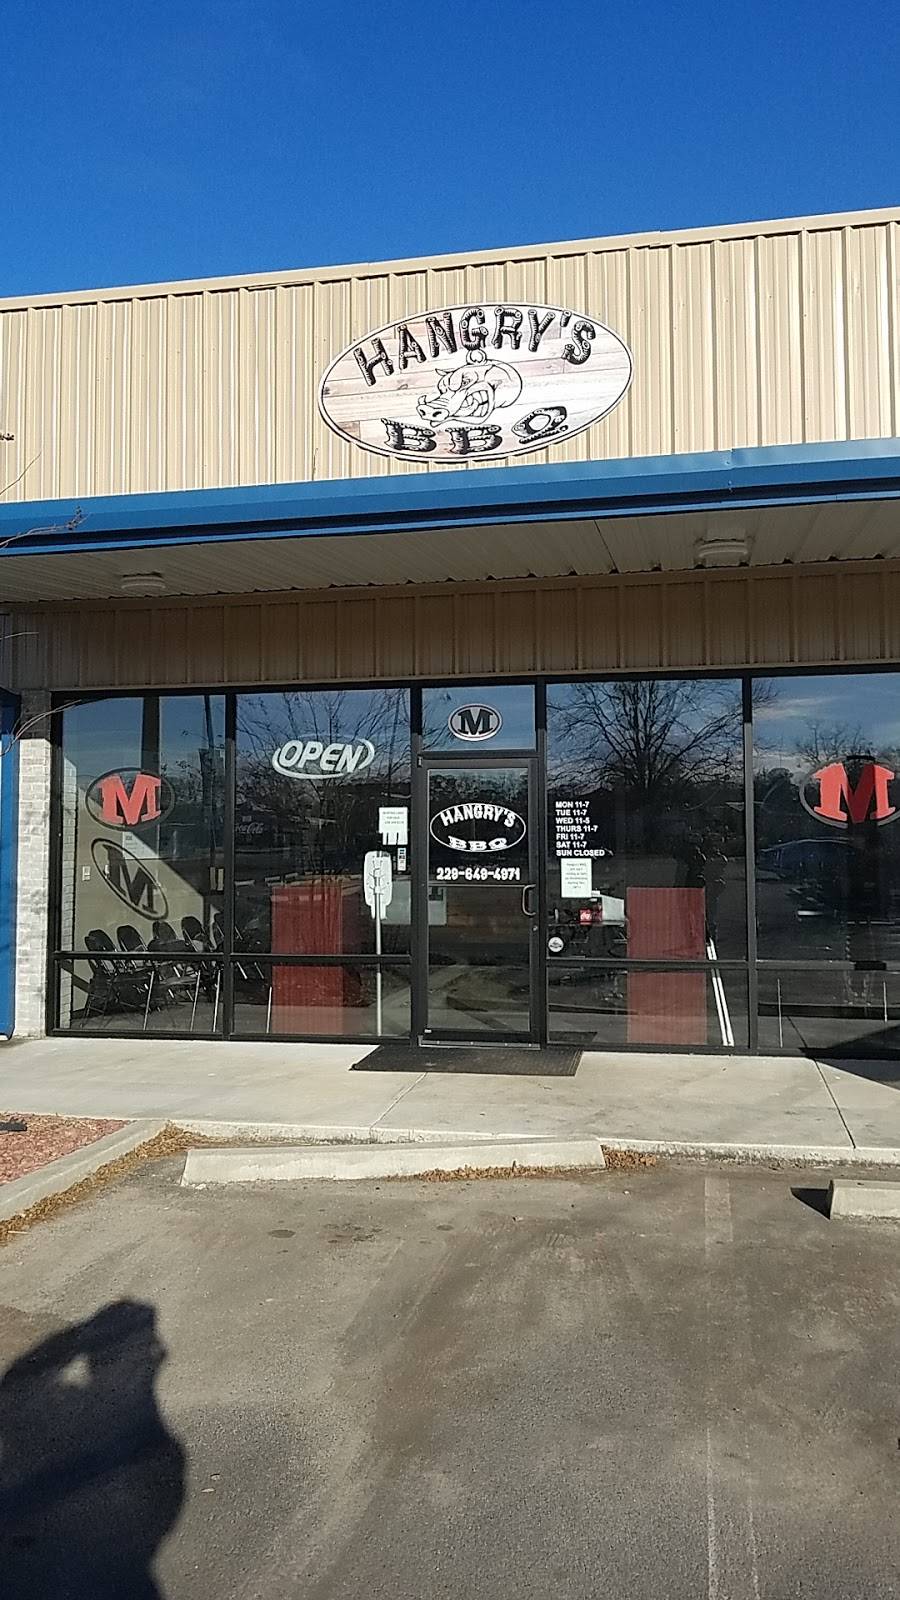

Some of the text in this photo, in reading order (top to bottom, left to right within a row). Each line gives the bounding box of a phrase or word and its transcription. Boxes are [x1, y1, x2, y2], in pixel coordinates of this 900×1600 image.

[353, 306, 597, 387] HANGRY'S
[381, 406, 568, 455] BBQ
[457, 708, 493, 735] M
[279, 739, 364, 773] OPEN
[97, 773, 162, 825] M
[811, 762, 896, 824] M
[440, 804, 516, 828] HANGRY'S
[448, 836, 507, 851] BBQ
[436, 867, 521, 880] 229-649-4971
